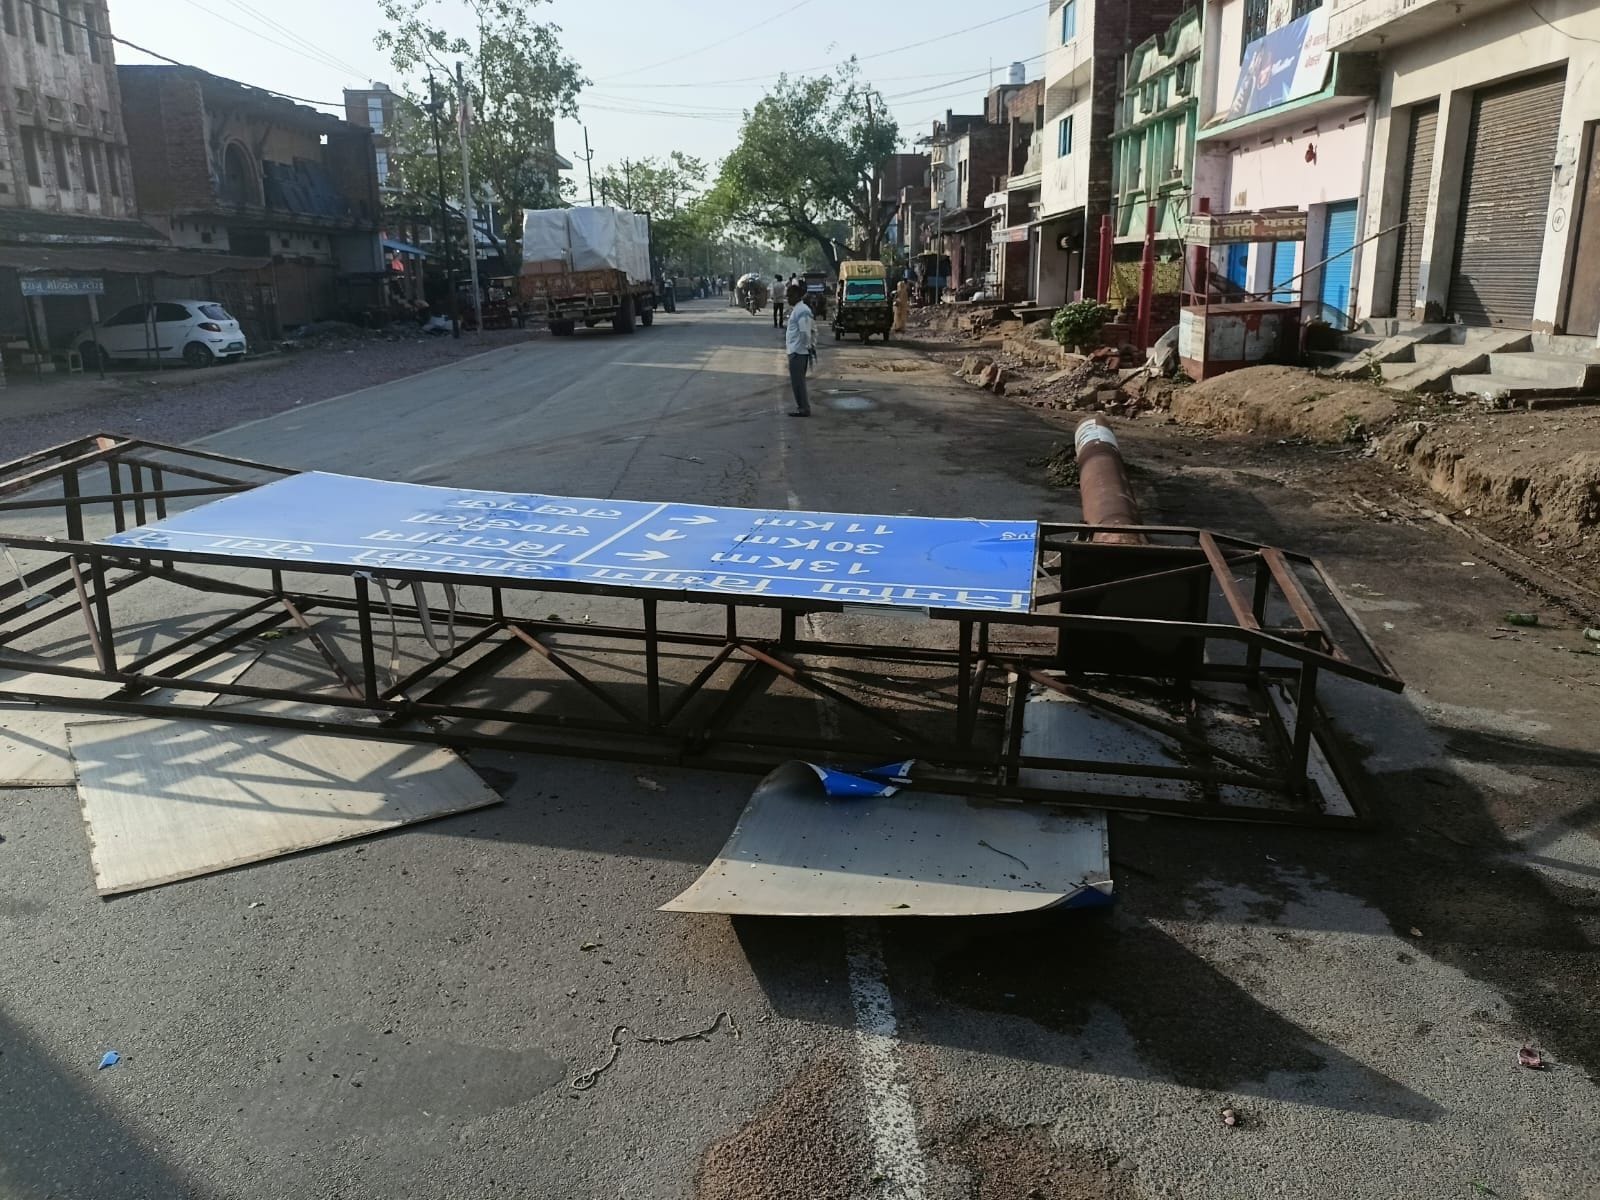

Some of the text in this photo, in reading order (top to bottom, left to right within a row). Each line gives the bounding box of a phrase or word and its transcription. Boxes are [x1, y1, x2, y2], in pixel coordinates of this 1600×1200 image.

[445, 499, 623, 520] लखनऊ
[400, 513, 590, 537] सण्डीला
[120, 532, 170, 547] में
[200, 538, 314, 556] सेवा
[359, 529, 566, 558] बिलग्राम
[584, 568, 773, 593] विभाग
[813, 582, 1023, 609] निर्माण
